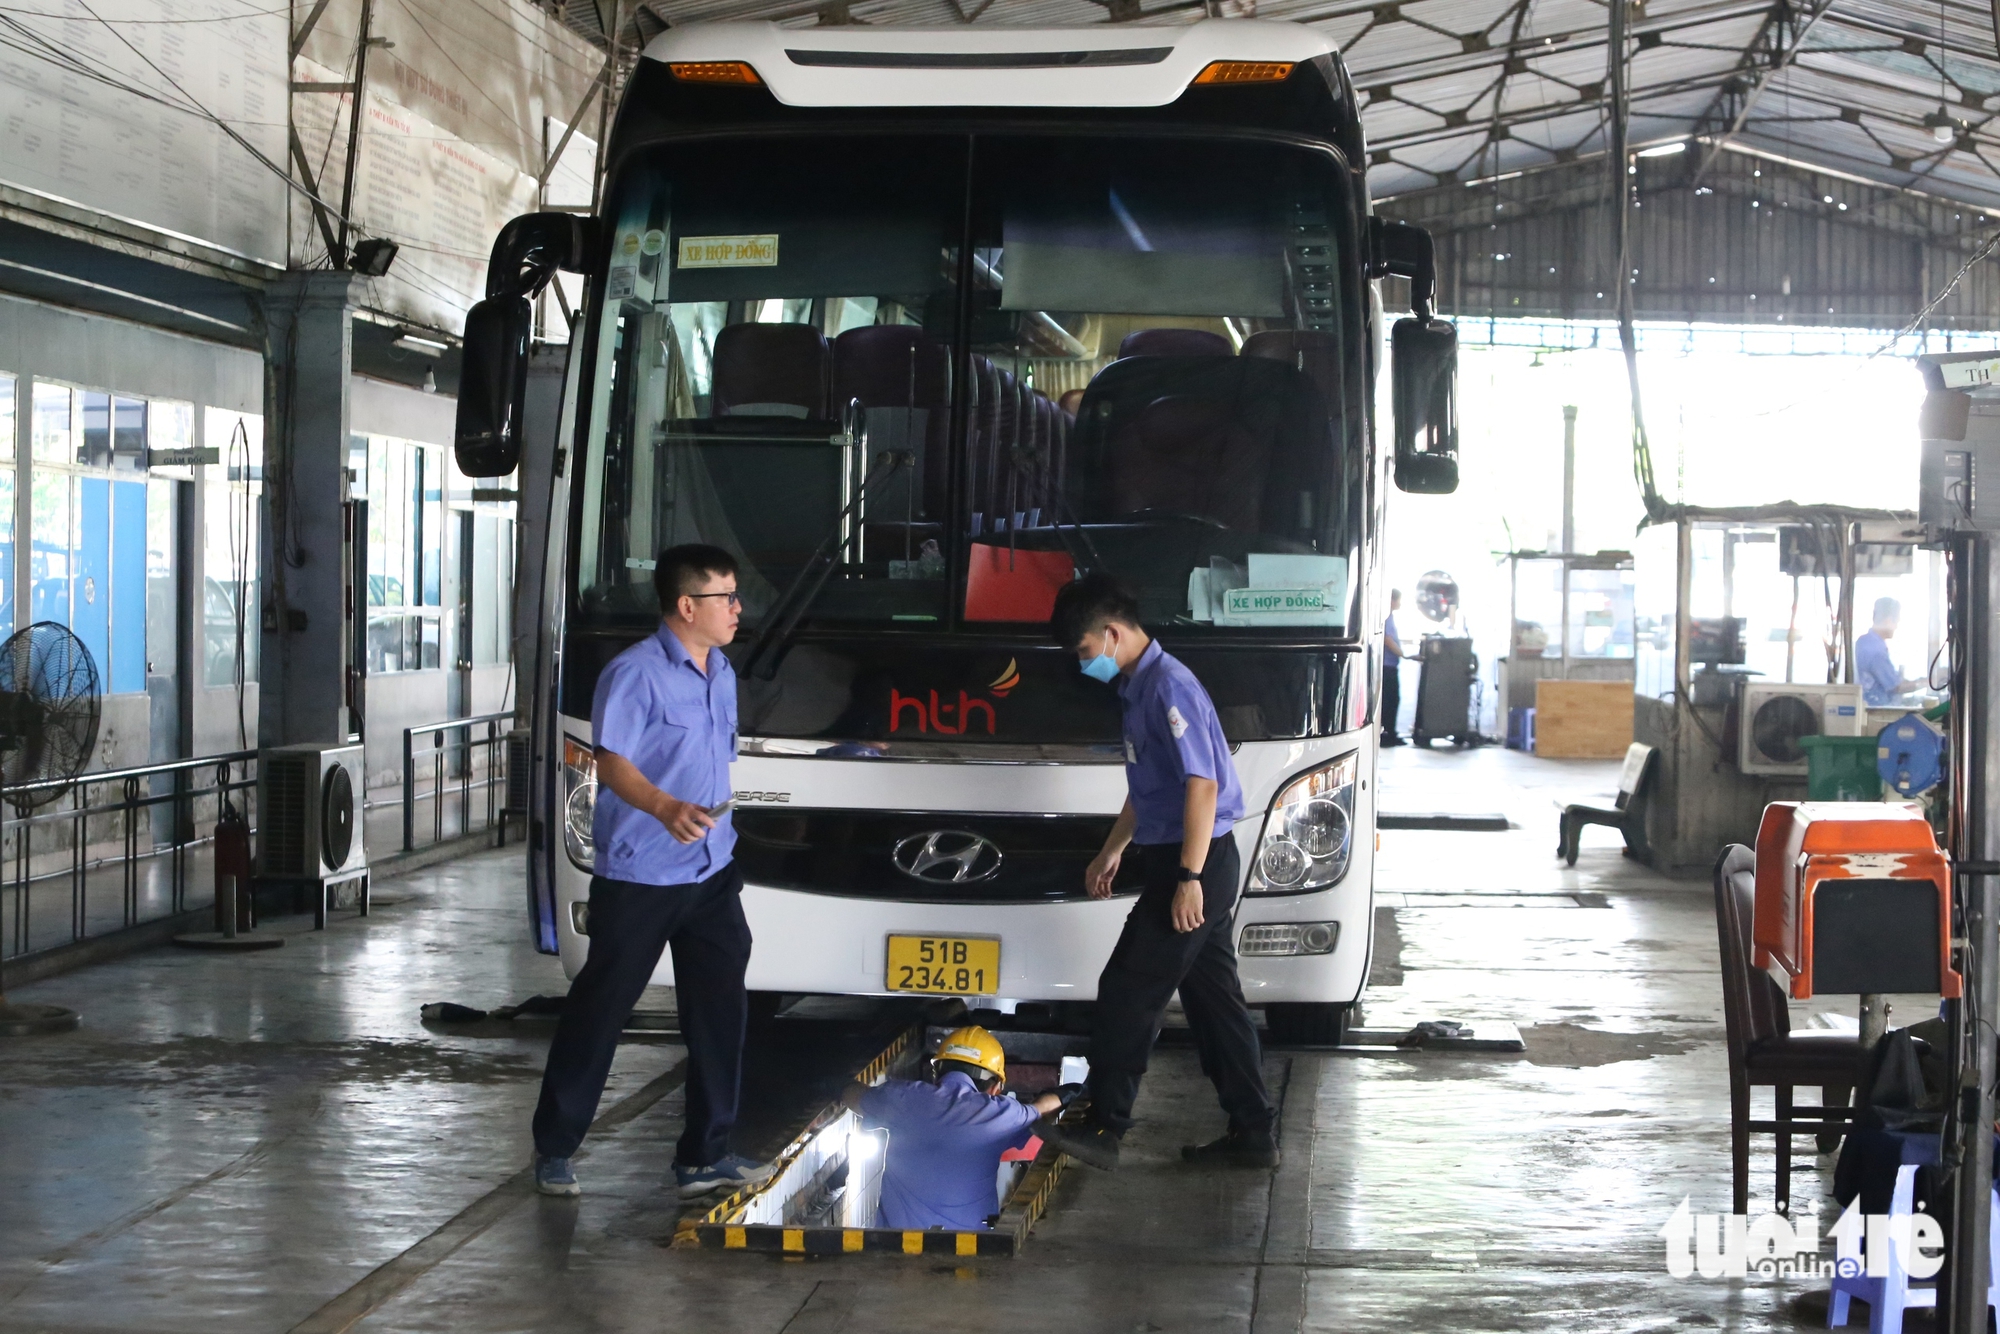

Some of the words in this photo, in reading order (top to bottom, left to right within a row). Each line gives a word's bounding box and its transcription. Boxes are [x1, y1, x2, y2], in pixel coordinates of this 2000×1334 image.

[686, 246, 702, 261] XE
[705, 242, 733, 264] HỢP
[735, 239, 771, 260] ĐỒNG
[163, 456, 185, 465] GIÁM
[188, 455, 205, 464] ĐỐC
[1233, 597, 1249, 608] XE
[1254, 595, 1282, 609] HỢP
[1286, 593, 1321, 607] ĐỒNG
[920, 940, 967, 964] 51B
[899, 966, 984, 992] 234.81
